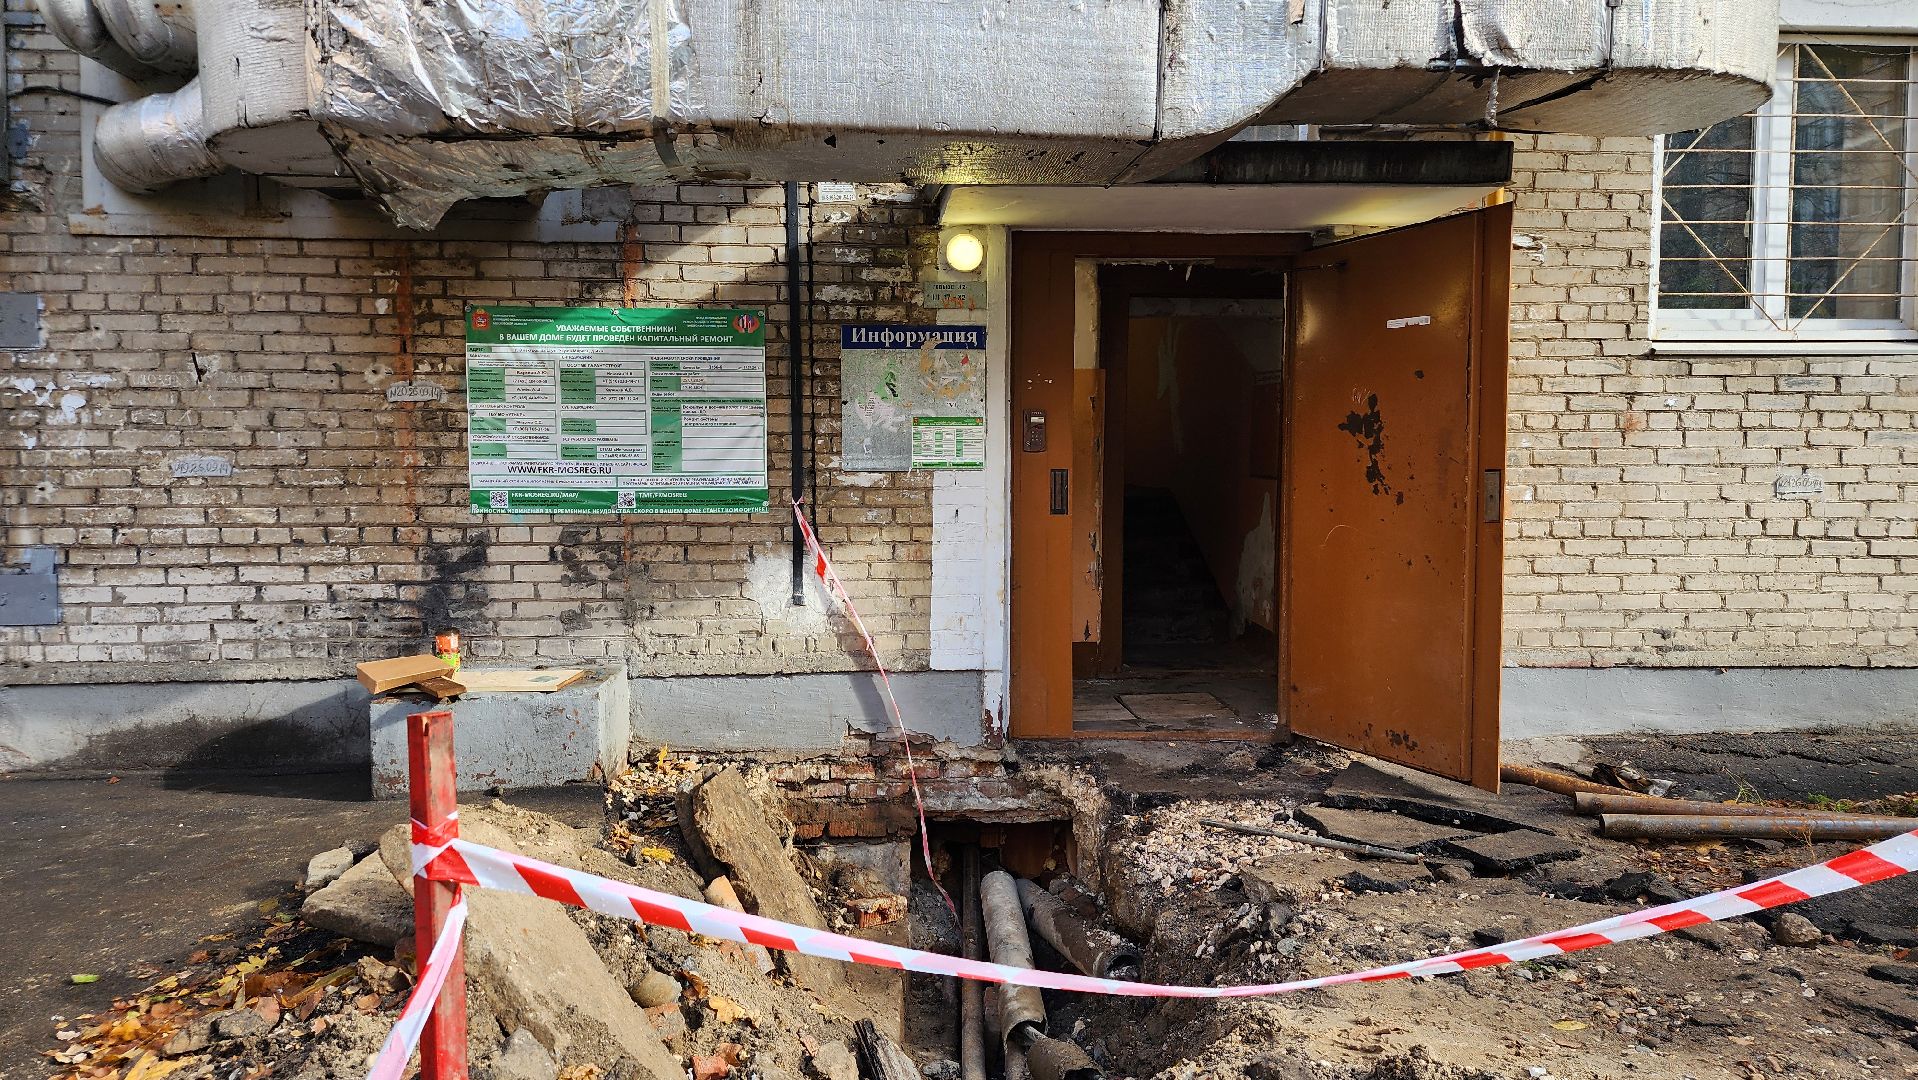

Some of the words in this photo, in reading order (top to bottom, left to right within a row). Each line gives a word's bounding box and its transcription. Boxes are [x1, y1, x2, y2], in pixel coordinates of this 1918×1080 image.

[611, 325, 677, 333] СОБСТВЕННИКИ!
[499, 333, 504, 341] В
[506, 333, 538, 341] ВАШЕМ
[539, 334, 564, 342] ДОМЕ
[593, 335, 635, 343] ПРОВЕДЕН
[637, 334, 698, 342] КАПИТАЛЬНЫЙ
[851, 327, 978, 347] Информация
[507, 465, 612, 474] WWW.FKR-MOSREG.RU
